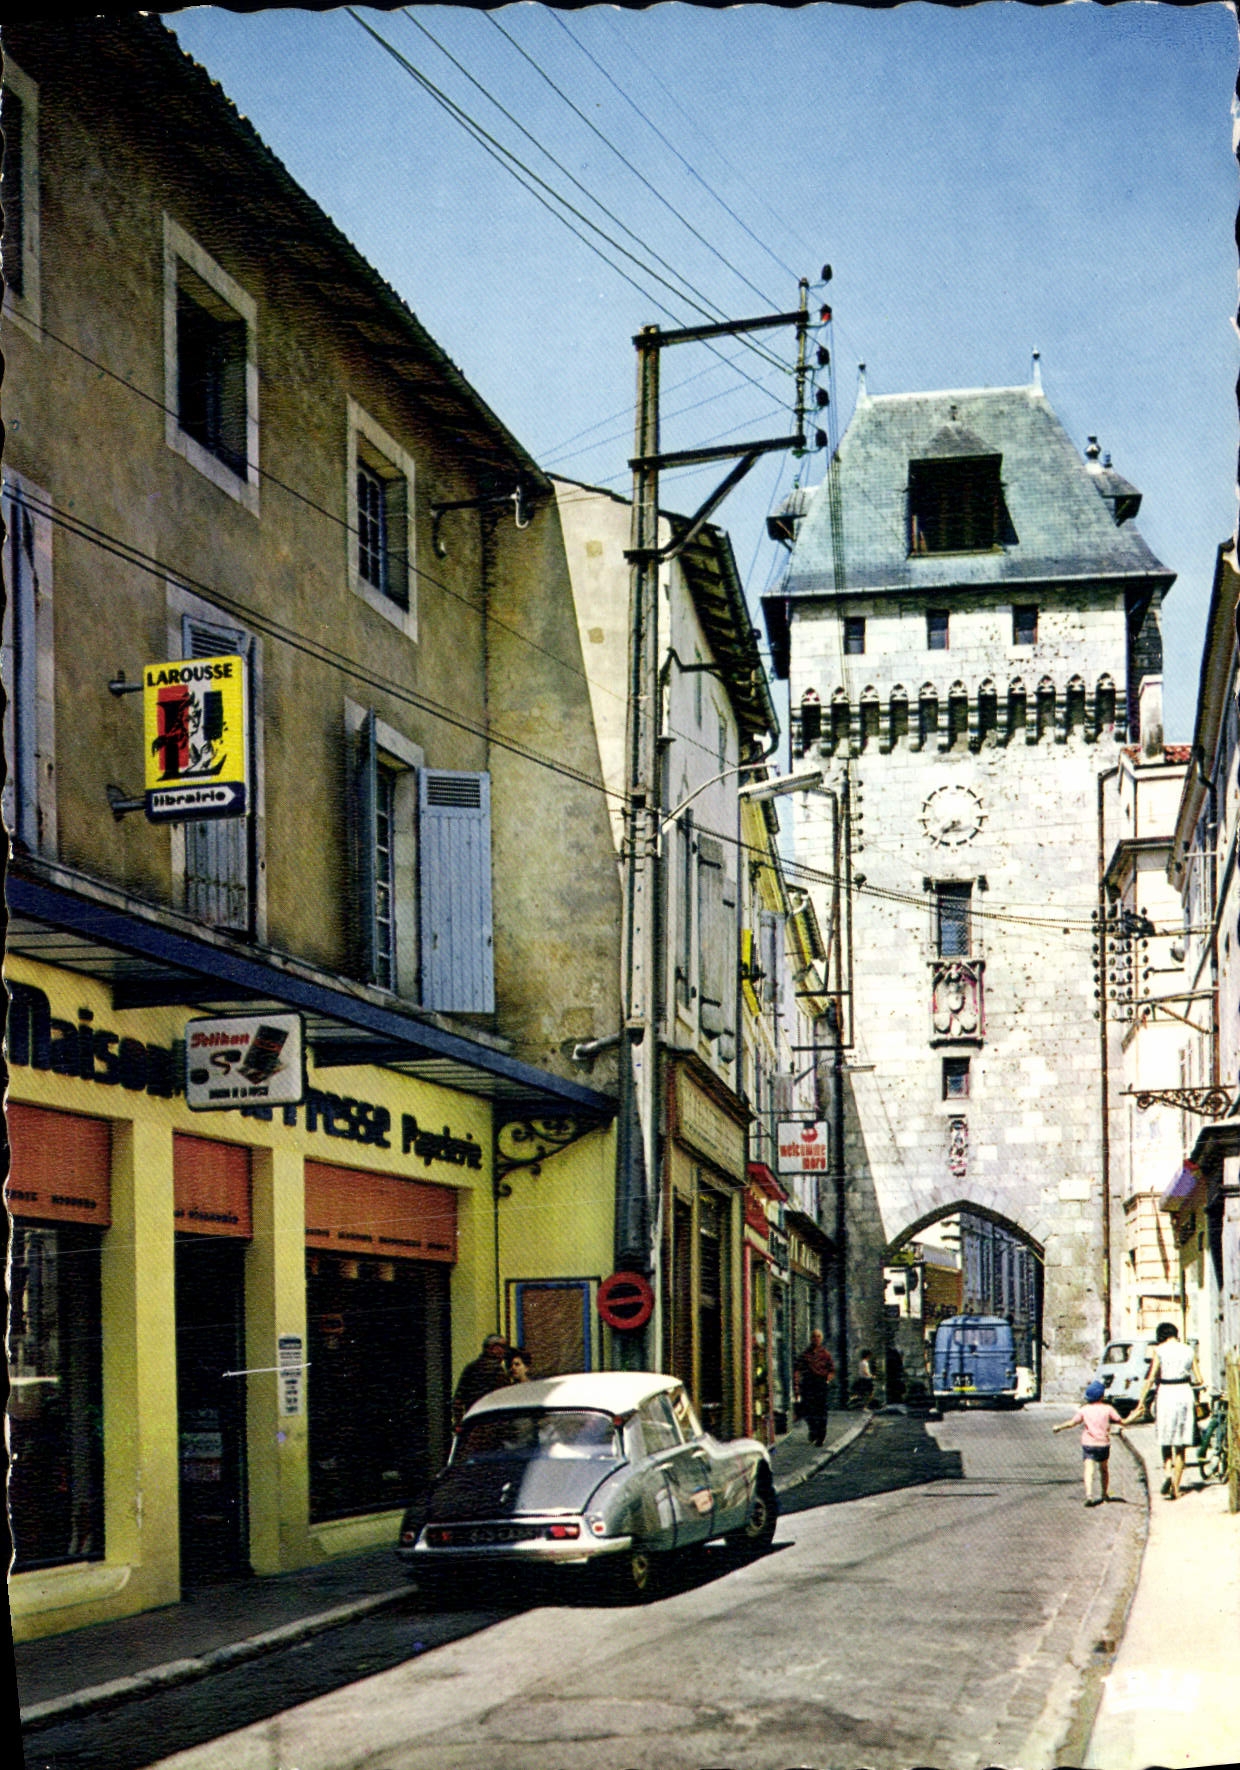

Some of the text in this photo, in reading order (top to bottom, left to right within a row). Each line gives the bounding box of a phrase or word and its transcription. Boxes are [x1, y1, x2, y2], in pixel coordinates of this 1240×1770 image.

[147, 663, 233, 687] LAROUSSE
[153, 790, 226, 807] librairie
[191, 1031, 250, 1048] Pelikan
